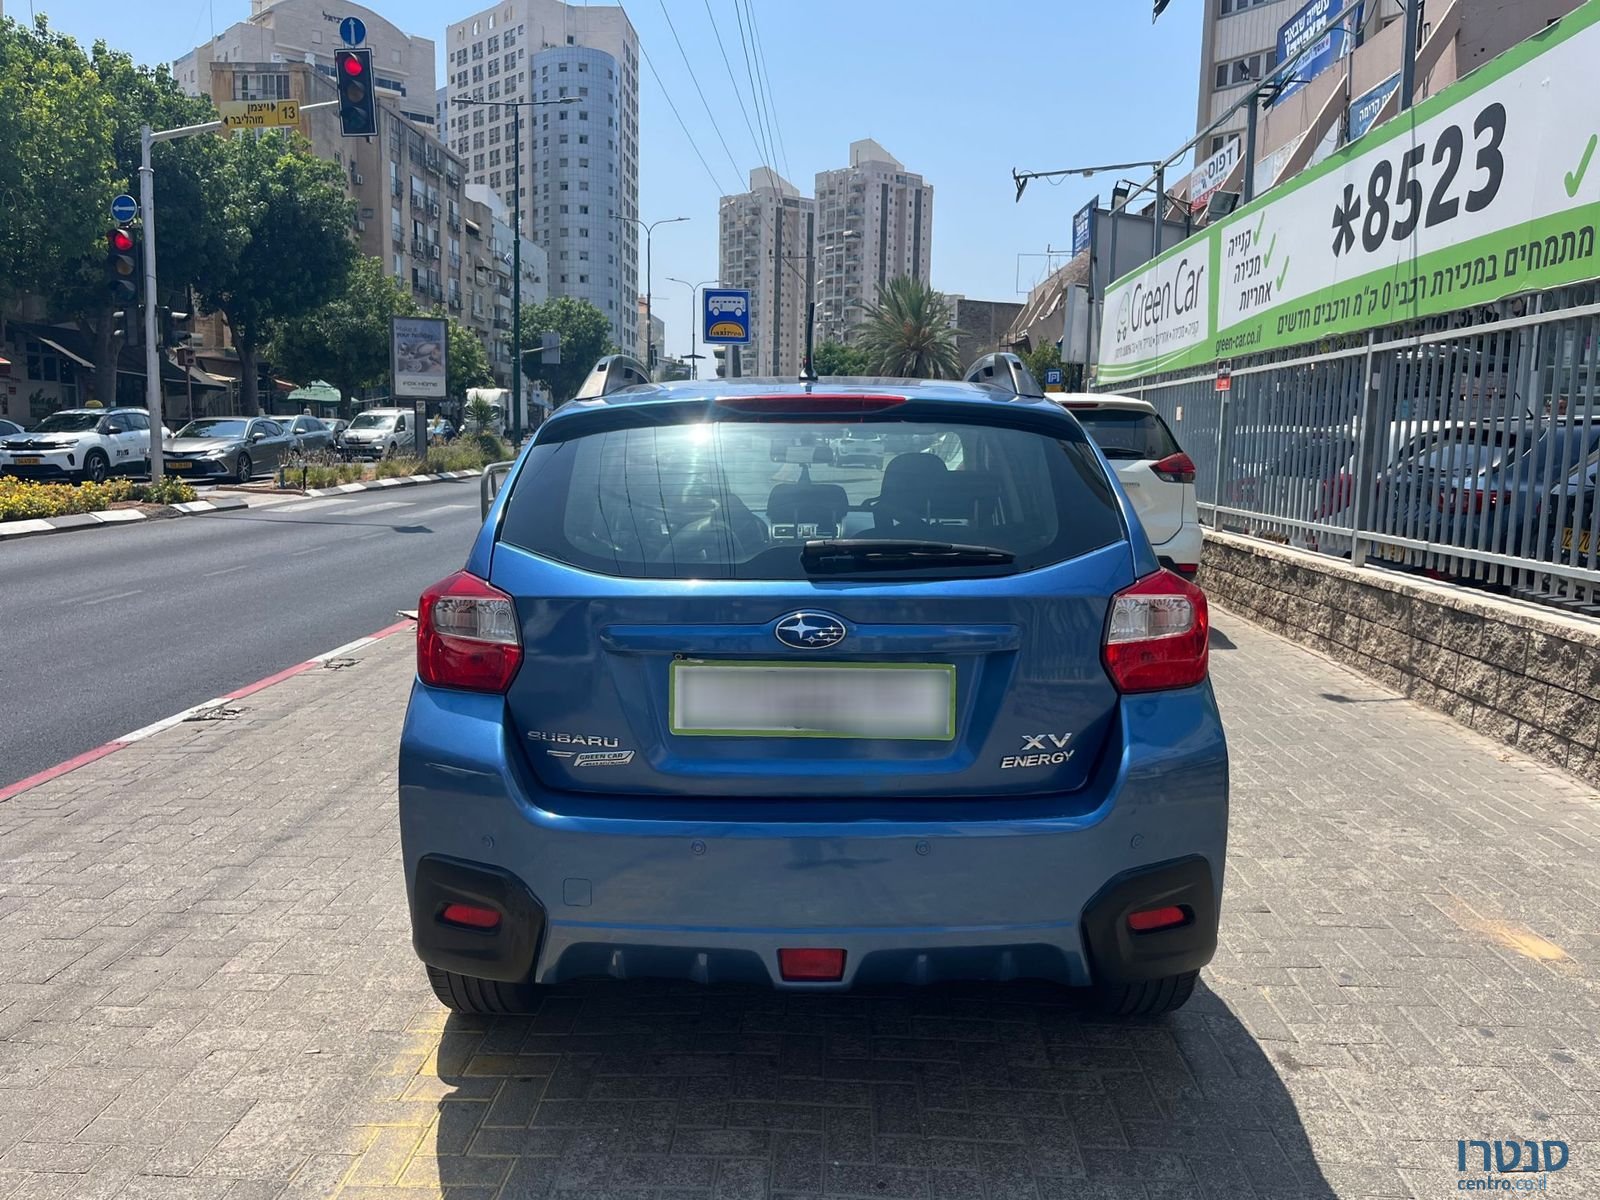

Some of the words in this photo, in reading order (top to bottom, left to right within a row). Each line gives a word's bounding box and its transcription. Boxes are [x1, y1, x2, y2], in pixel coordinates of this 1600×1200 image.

[230, 113, 264, 125] מוהליבר
[247, 103, 270, 115] ויצמן
[282, 106, 296, 119] 13
[1208, 147, 1233, 179] דפוס
[1227, 229, 1252, 258] קנייה
[1504, 225, 1594, 278] מתמחים
[1233, 254, 1261, 284] מכירה
[1430, 254, 1498, 297] במכירת
[1131, 281, 1170, 332] Green
[1174, 258, 1204, 315] Car
[1239, 280, 1273, 312] אחריות
[1353, 285, 1378, 315] ק"מ
[1382, 281, 1391, 310] 0
[1395, 275, 1427, 306] רכבי
[1277, 308, 1310, 335] חדשים
[1313, 295, 1350, 326] ורכבים
[1215, 324, 1262, 357] green-car.co.il
[527, 731, 619, 748] SUBARU
[1021, 732, 1073, 751] XV
[1001, 749, 1075, 769] ENERGY
